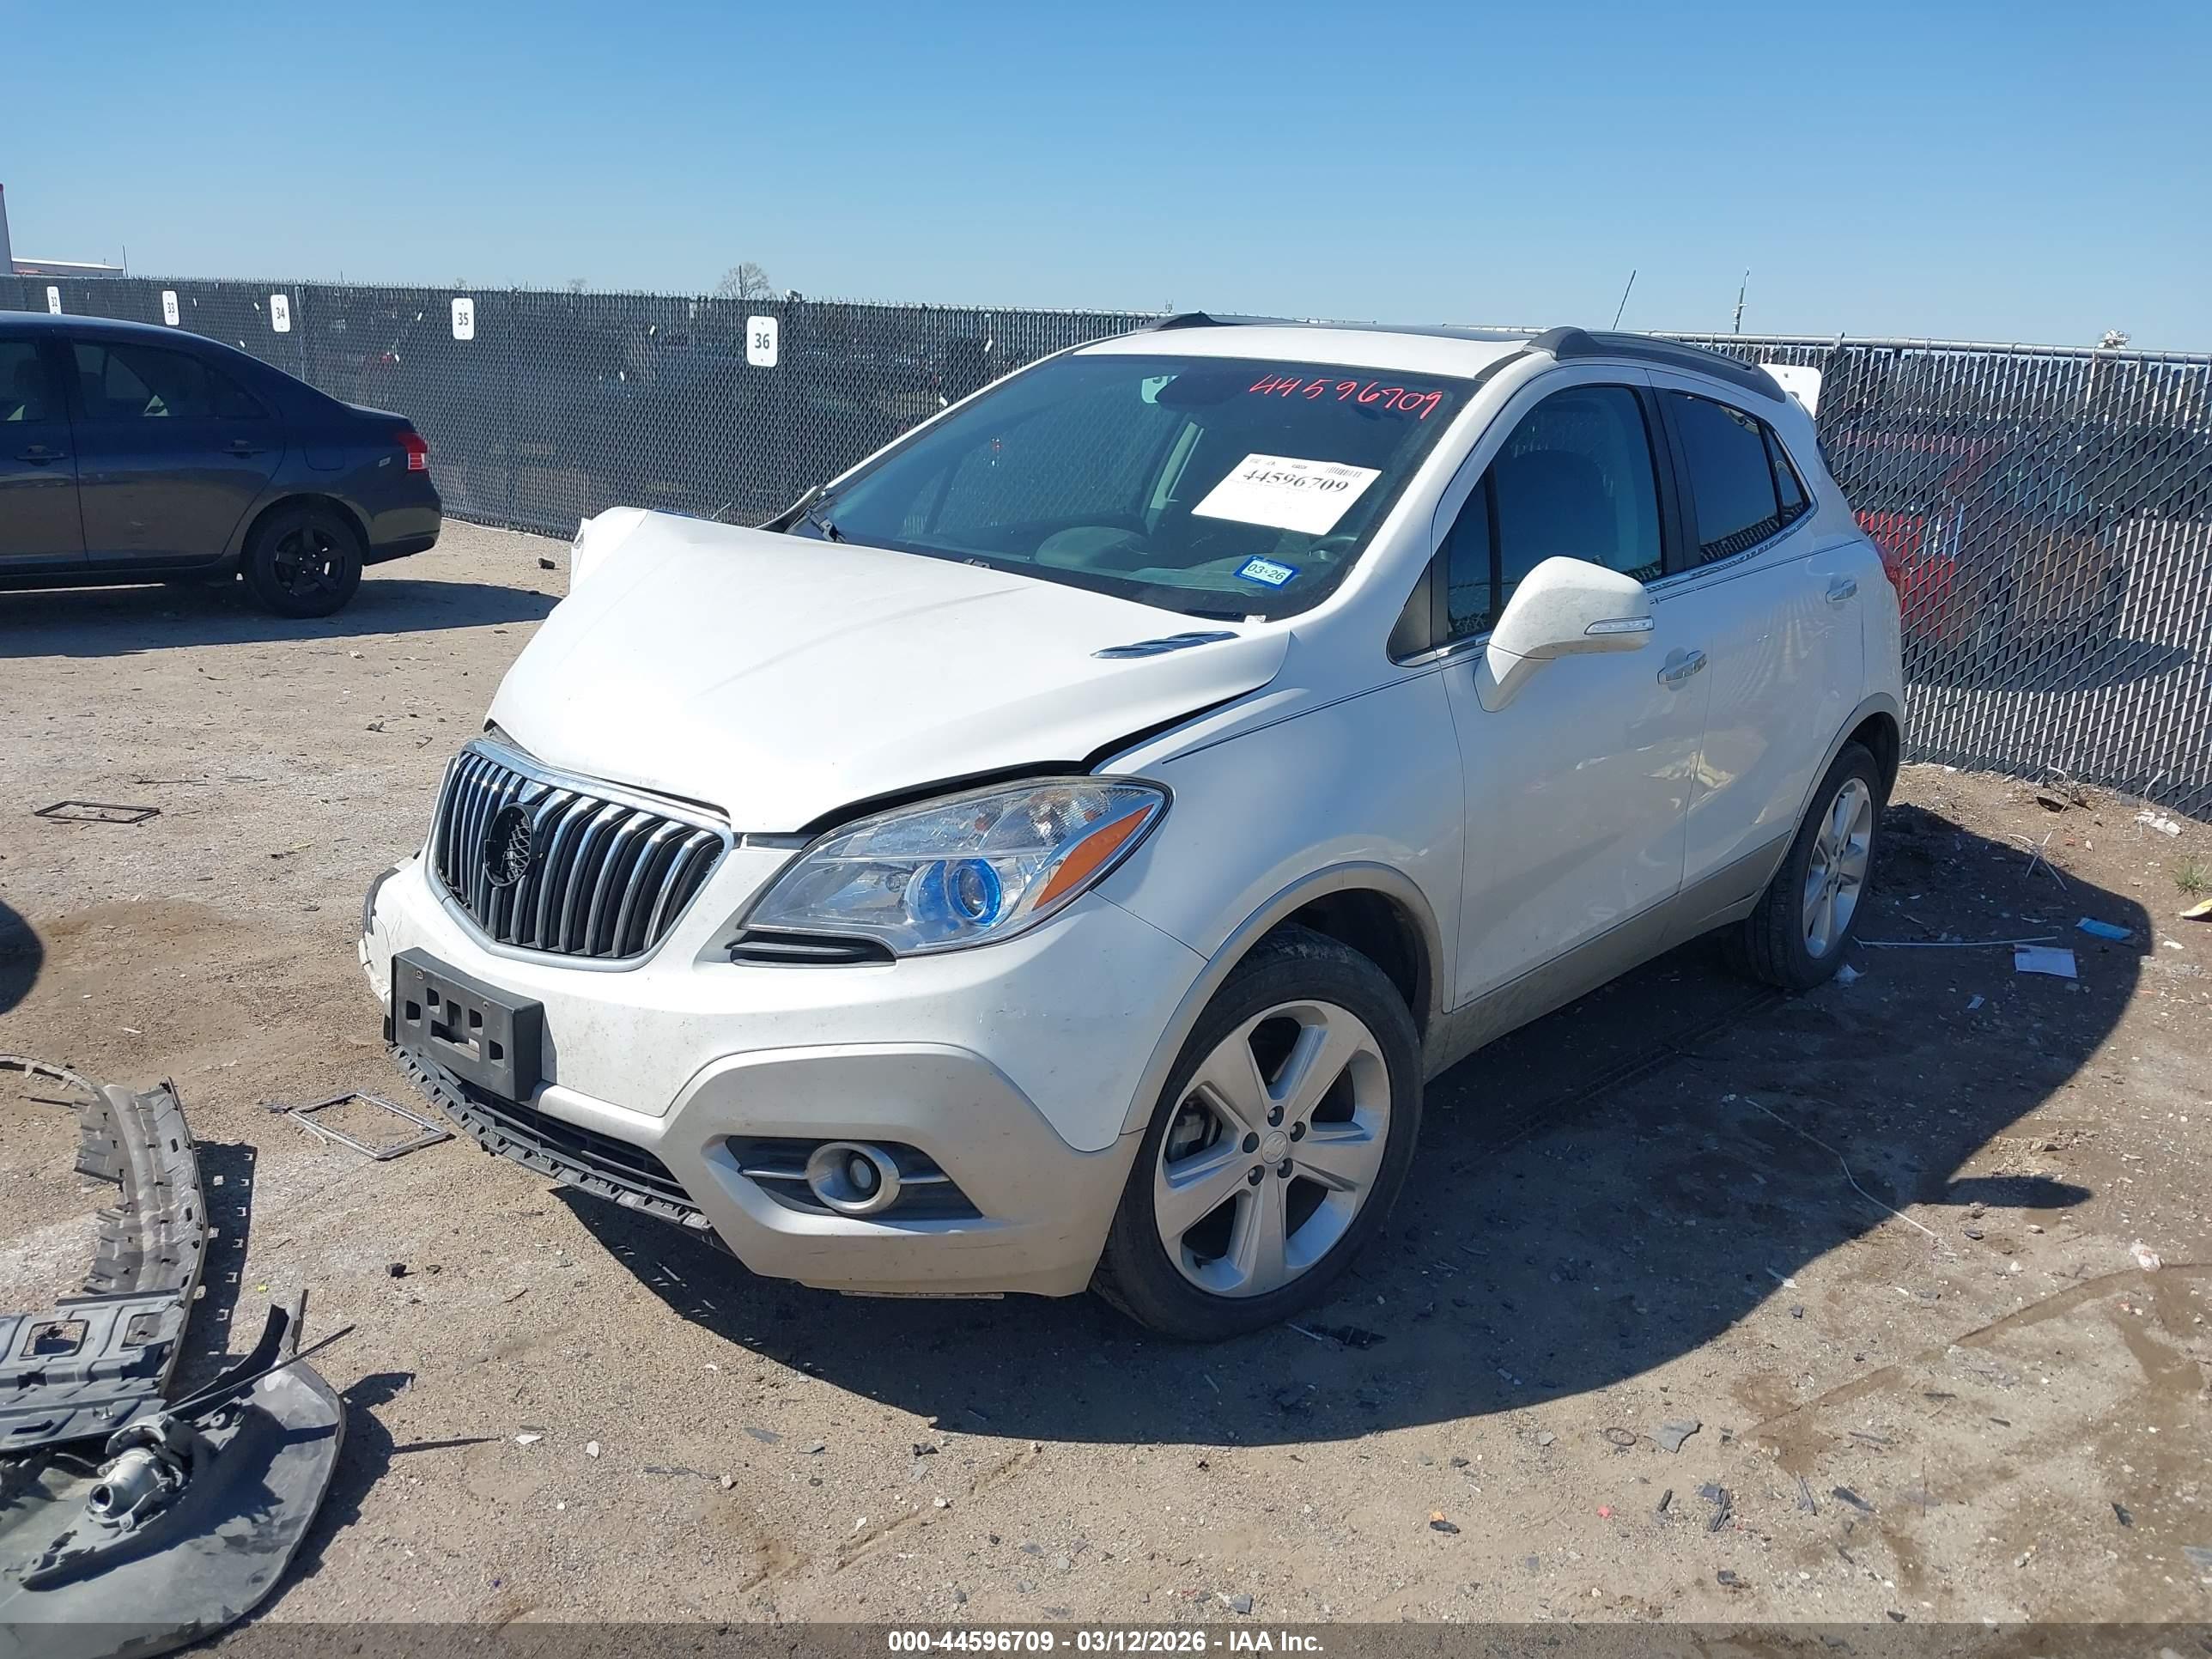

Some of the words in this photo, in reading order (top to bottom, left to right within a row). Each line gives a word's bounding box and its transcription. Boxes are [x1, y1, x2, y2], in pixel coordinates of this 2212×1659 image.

[167, 302, 175, 313] 33
[276, 307, 285, 319] 34
[458, 312, 469, 325] 35
[755, 332, 770, 349] 36
[1249, 374, 1443, 420] 44596709
[1243, 470, 1349, 492] 44596709
